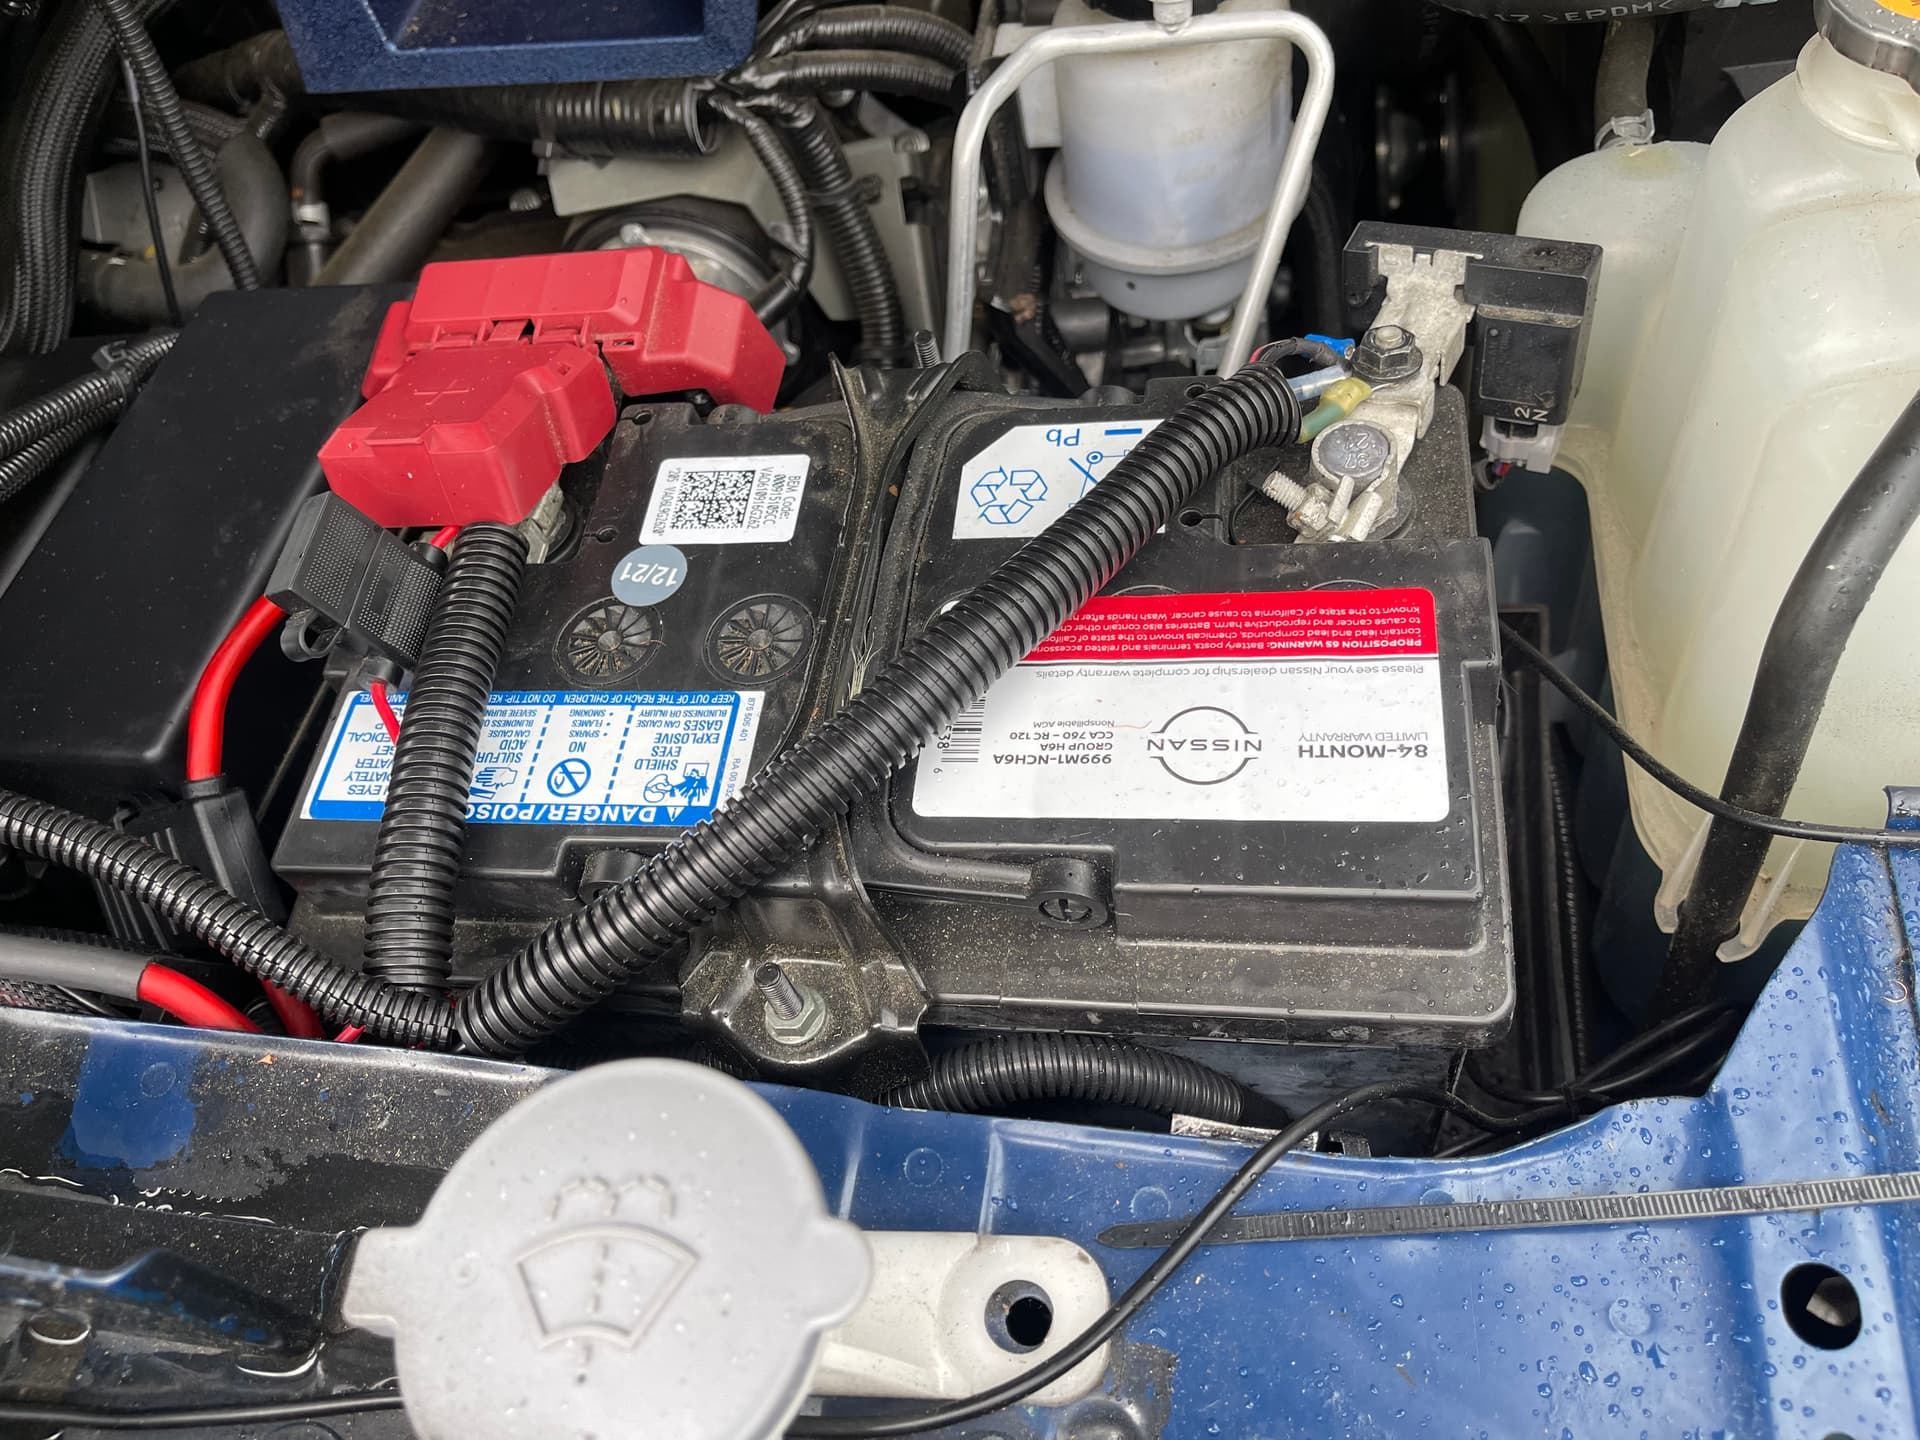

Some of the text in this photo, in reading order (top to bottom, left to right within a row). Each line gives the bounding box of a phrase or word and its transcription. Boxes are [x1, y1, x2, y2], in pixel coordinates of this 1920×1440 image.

[1046, 428, 1080, 447] Pb
[778, 475, 801, 520] BEM Code:
[619, 561, 678, 587] 12/21
[1207, 610, 1239, 618] cause
[1240, 610, 1252, 618] to
[1254, 608, 1304, 617] California
[1305, 608, 1317, 617] of
[1318, 608, 1347, 616] state
[1348, 608, 1367, 616] the
[1382, 606, 1420, 615] known
[1080, 613, 1105, 622] after
[1106, 613, 1138, 621] hands
[1139, 612, 1168, 621] Wash
[1374, 617, 1407, 625] cause
[1408, 617, 1421, 625] to
[1164, 621, 1211, 631] Batteries
[1244, 618, 1311, 628] reproductive
[1312, 619, 1334, 627] and
[1335, 618, 1372, 627] cancer
[1073, 624, 1101, 633] other
[1102, 623, 1141, 632] contain
[1142, 623, 1163, 632] also
[1379, 627, 1421, 637] contain
[1117, 633, 1135, 642] the
[1136, 634, 1148, 642] to
[1149, 633, 1184, 641] known
[1185, 631, 1238, 640] chemicals
[1307, 629, 1330, 638] lead
[1331, 629, 1353, 638] and
[1354, 629, 1378, 638] lead
[1078, 634, 1089, 643] of
[1090, 634, 1116, 643] state
[1341, 638, 1422, 648] PROPOSITION
[1084, 644, 1120, 653] related
[1121, 644, 1141, 652] and
[1143, 643, 1191, 652] terminals
[1225, 641, 1264, 650] Battery
[1266, 640, 1323, 649] WARNING:
[1325, 640, 1340, 648] 65
[1076, 668, 1131, 679] warranty
[1132, 667, 1190, 678] complete
[1192, 668, 1210, 678] for
[1211, 666, 1277, 677] dealership
[1279, 666, 1322, 676] Nissan
[1325, 665, 1354, 675] your
[1355, 666, 1379, 674] see
[1381, 665, 1424, 674] Please
[521, 694, 541, 703] NOT
[542, 694, 556, 703] DO
[562, 694, 735, 704] KEEP OUT OF THE REACH OF CHILDREN
[484, 709, 537, 717] SEVERE BURN
[568, 709, 606, 717] SMOKING
[638, 709, 727, 718] BLINDNESS OR INJURY
[490, 719, 534, 727] BLINDNESS
[571, 719, 603, 727] FLAMES
[635, 719, 723, 731] GASES CAN CAUSE
[1032, 719, 1114, 729] Nonspillable AGM
[347, 732, 391, 743] EDICAL
[487, 729, 531, 738] CAN CAUSE
[568, 729, 600, 738] SPARKS
[653, 732, 720, 744] EXPLOSIVE
[738, 728, 749, 742] 401
[1009, 732, 1030, 740] 120
[1033, 731, 1050, 740] RC
[1062, 731, 1086, 740] 760
[1089, 731, 1114, 740] CCA
[1298, 731, 1428, 743] LIMITED WARRANTY
[499, 739, 528, 750] ACID
[568, 741, 586, 752] NO
[1039, 742, 1113, 752] GROUP H6A
[1147, 739, 1262, 752] NISSAN
[650, 746, 682, 757] EYES
[1297, 743, 1428, 759] 84-MONTH
[992, 753, 1113, 765] 999M1-NCH6A
[634, 758, 678, 771] SHIELD
[731, 758, 741, 771] RA
[346, 785, 382, 795] EYES
